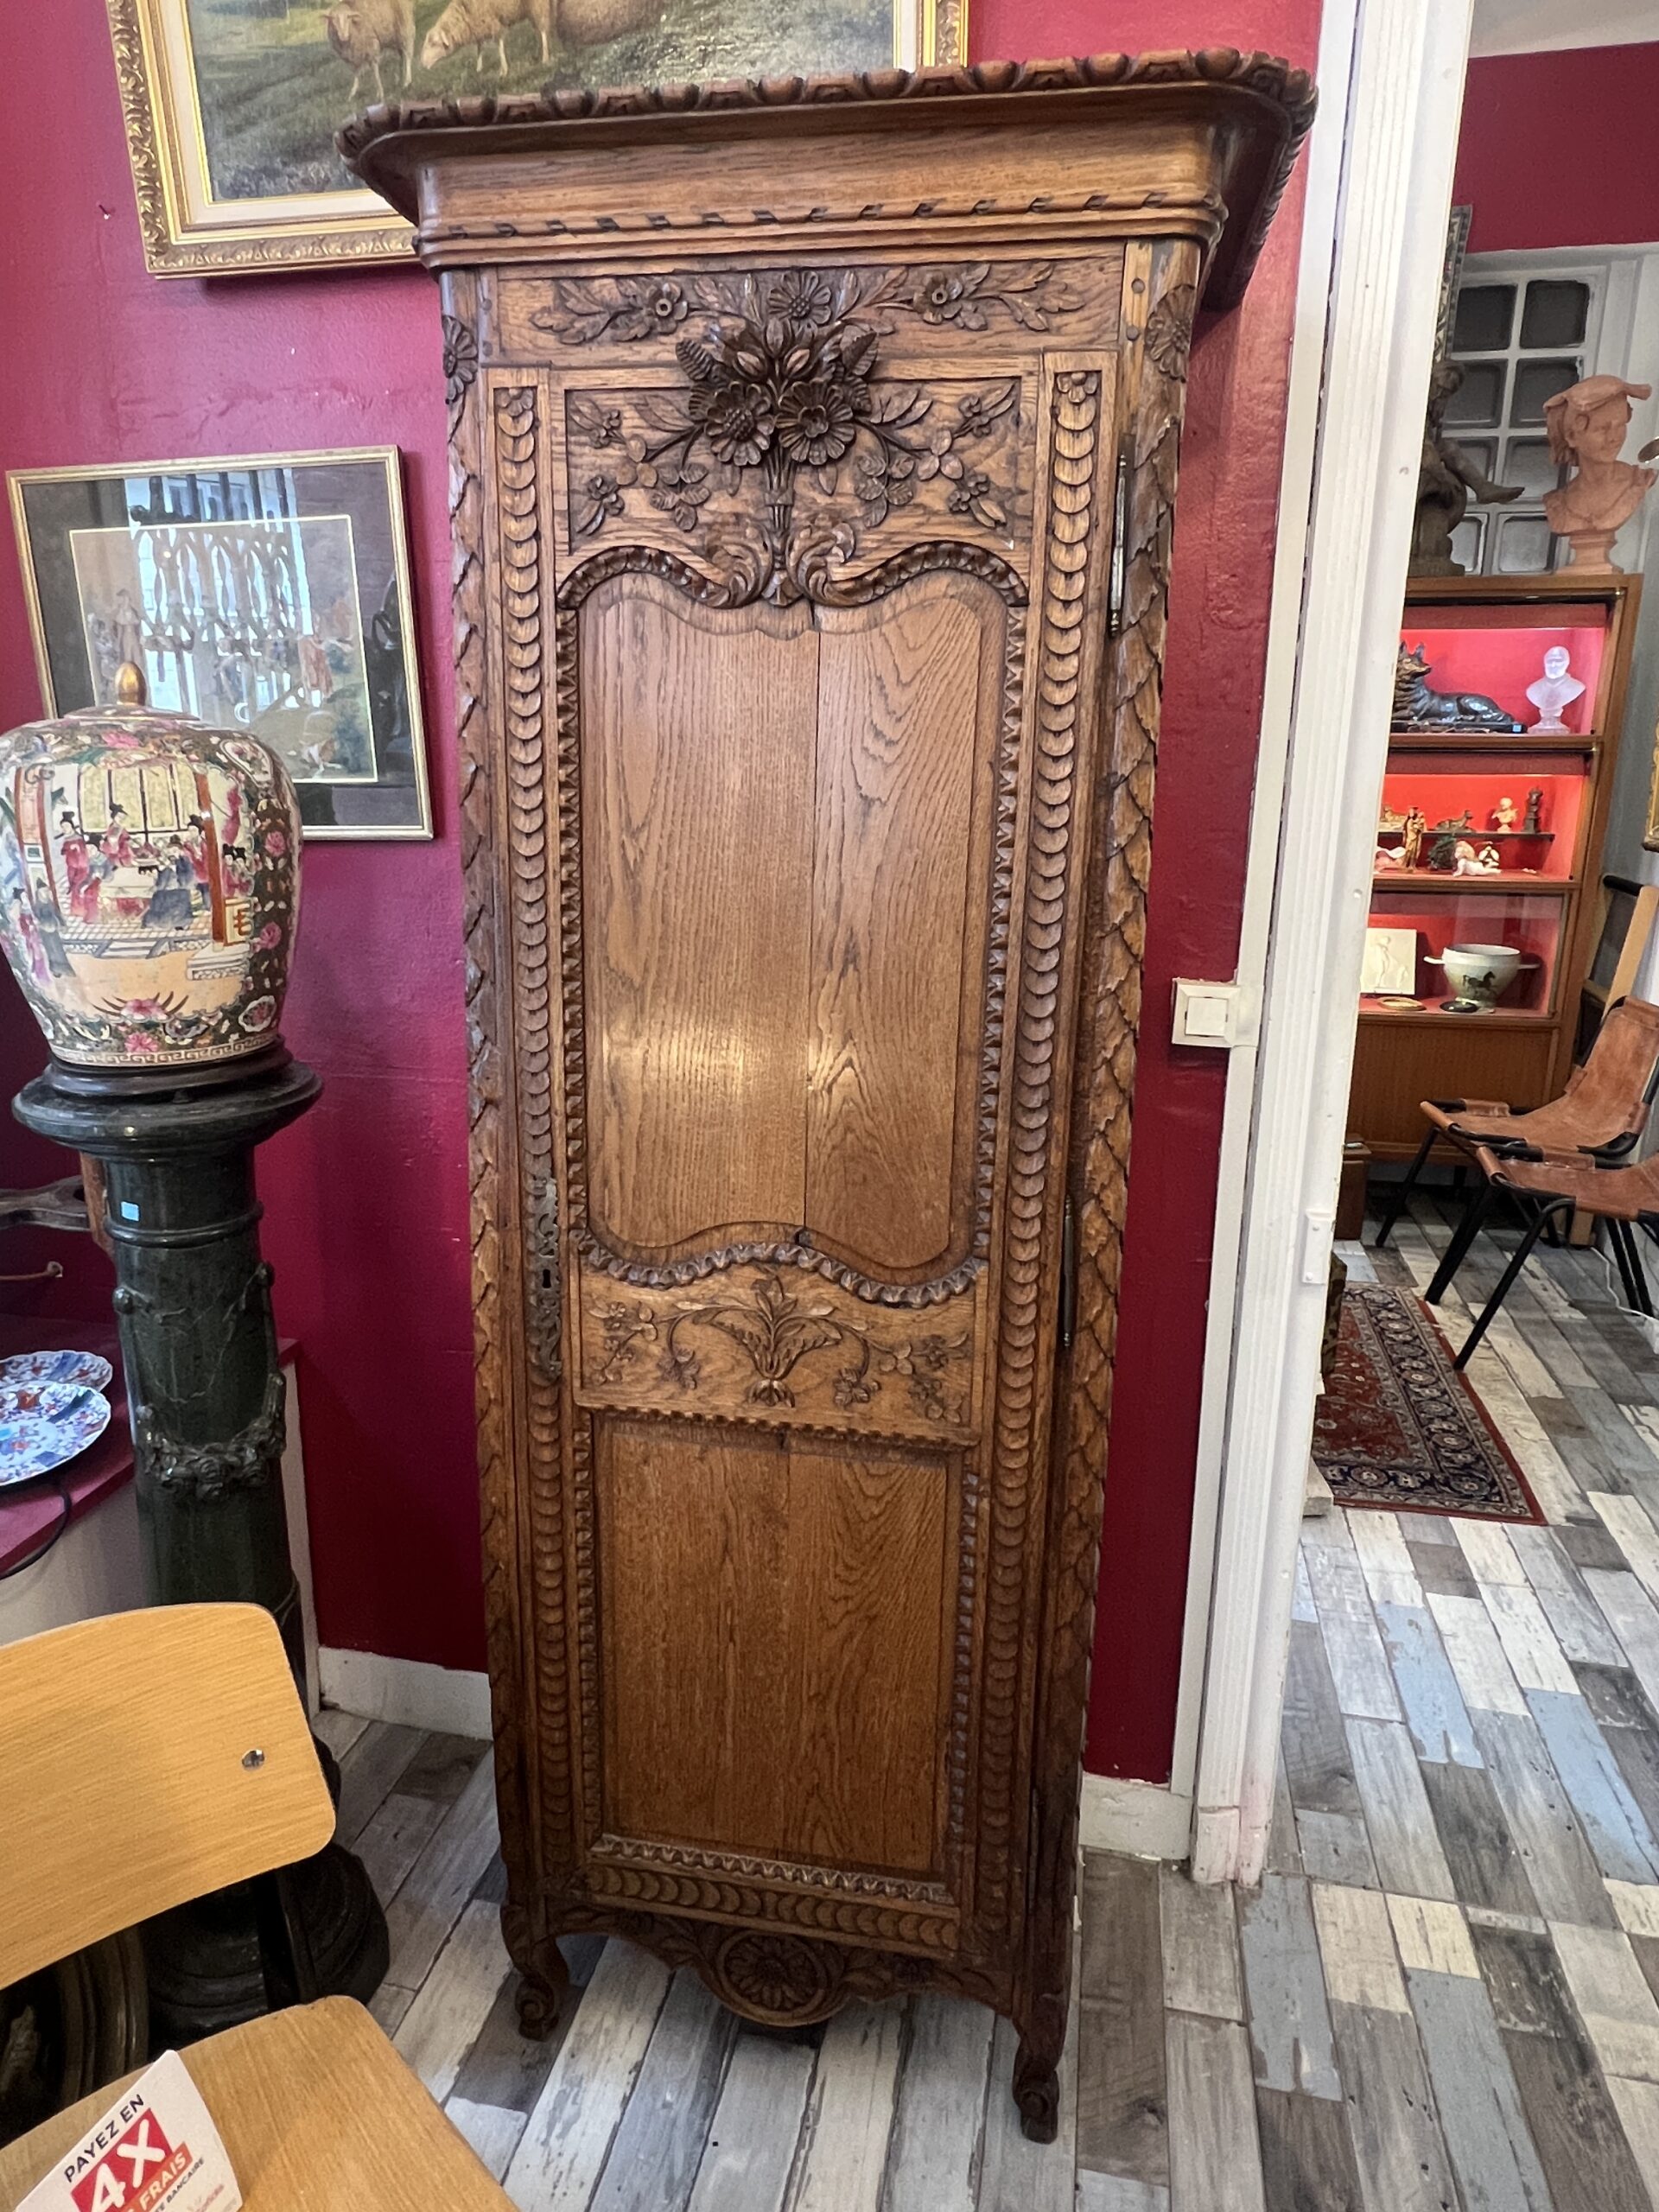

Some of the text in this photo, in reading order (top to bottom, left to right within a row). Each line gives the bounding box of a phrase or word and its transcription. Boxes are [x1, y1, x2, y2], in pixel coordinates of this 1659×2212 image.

[65, 2094, 145, 2183] PAYEZ EN
[91, 2119, 166, 2212] 4X
[139, 2151, 187, 2211] FRAIS
[166, 2156, 205, 2203] BANCAIRE
